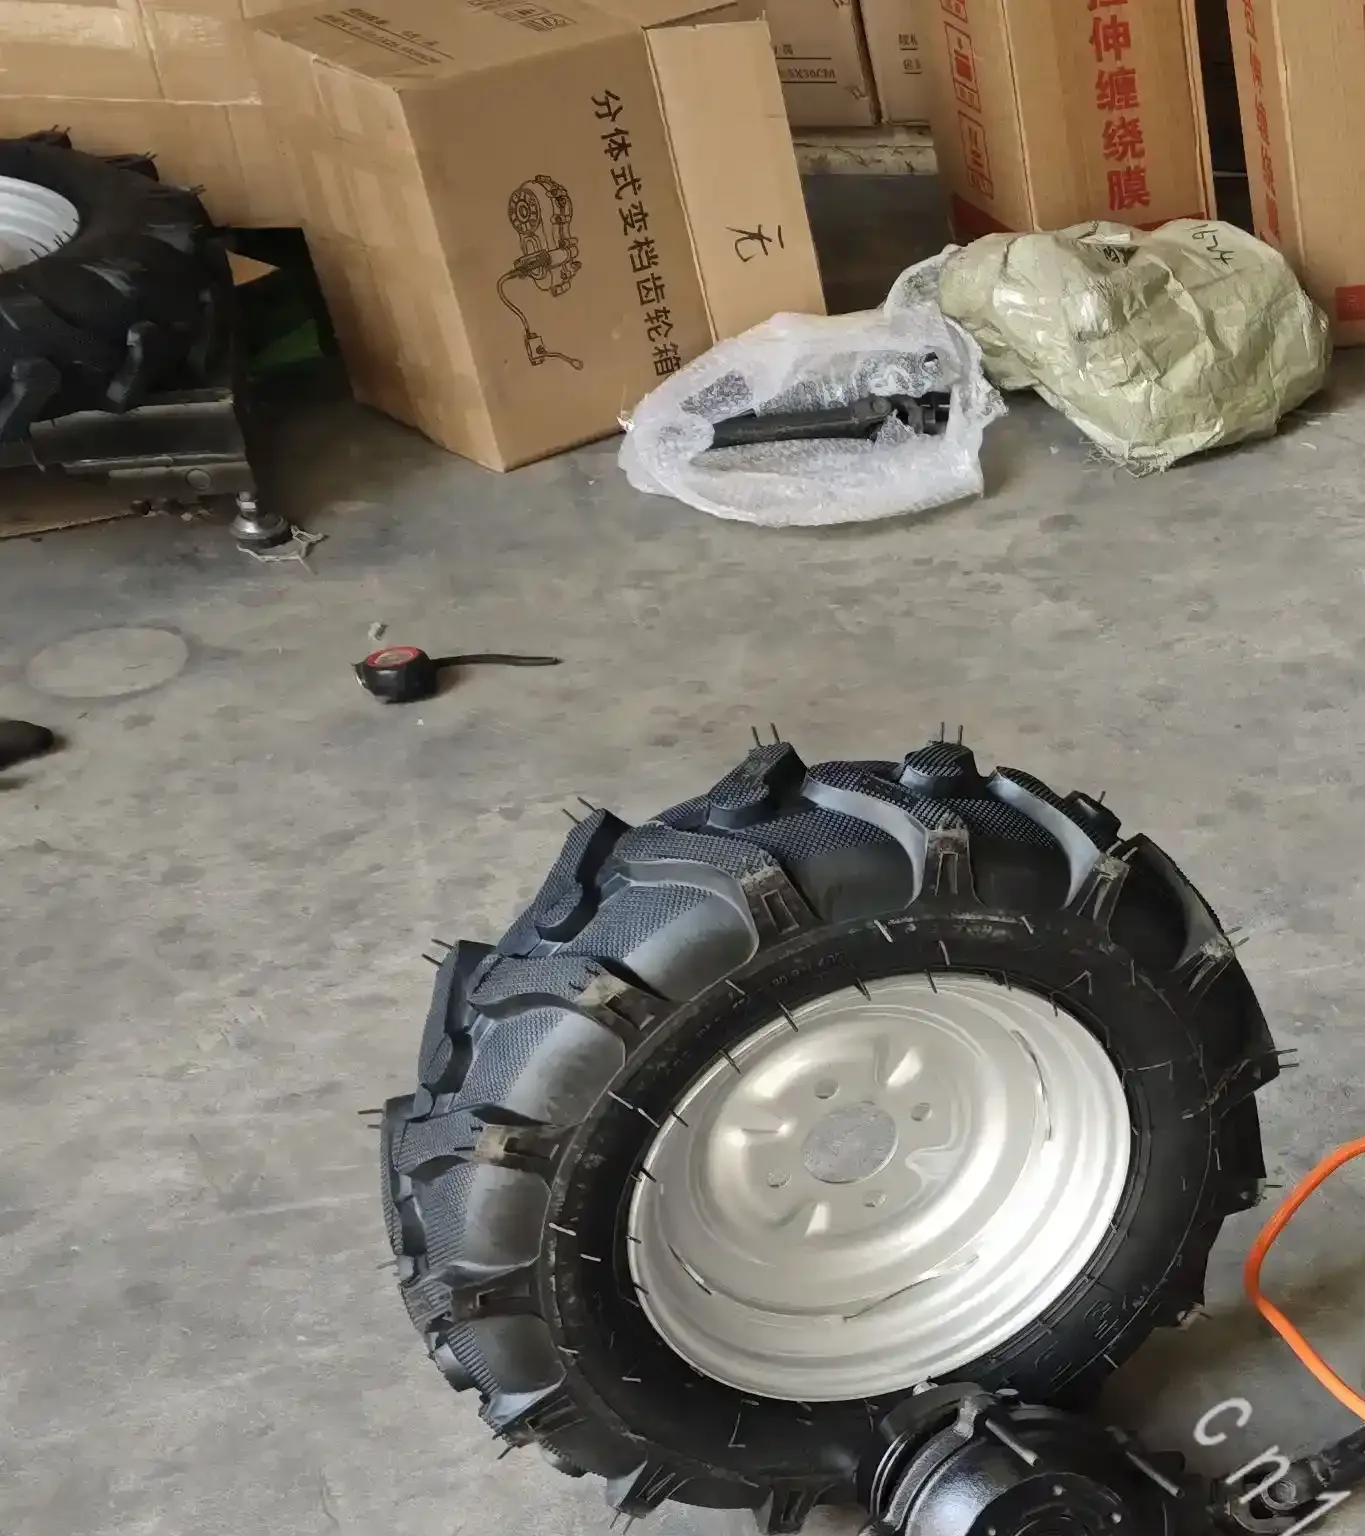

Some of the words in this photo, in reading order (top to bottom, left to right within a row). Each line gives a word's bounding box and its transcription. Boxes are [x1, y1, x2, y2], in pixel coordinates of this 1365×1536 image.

[1087, 0, 1150, 211] 伸缠绕膜
[591, 90, 681, 376] 分体式变档齿轮箱
